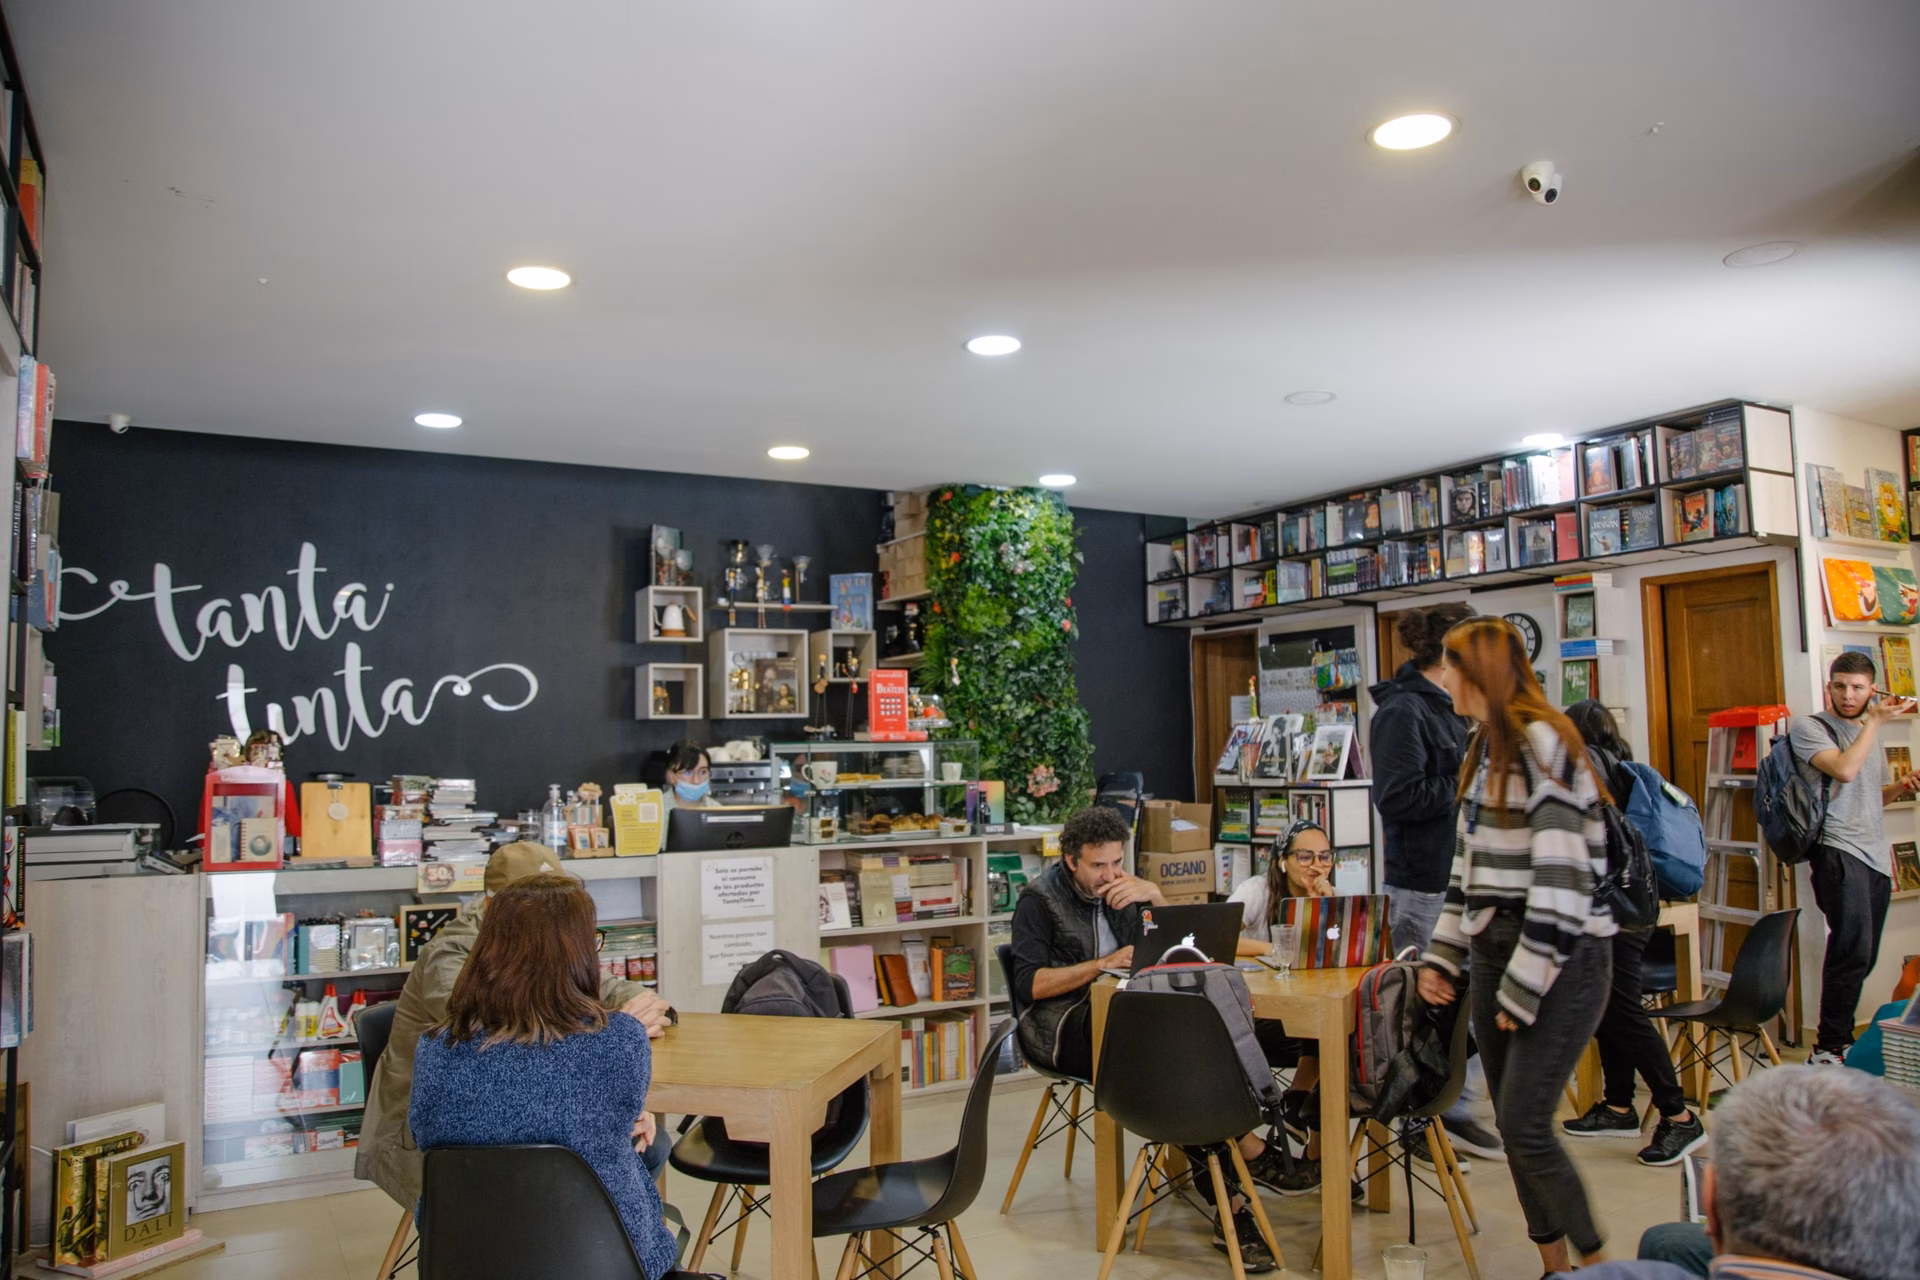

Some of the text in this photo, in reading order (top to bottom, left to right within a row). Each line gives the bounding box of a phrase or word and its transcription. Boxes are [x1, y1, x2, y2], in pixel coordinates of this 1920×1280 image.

[110, 541, 396, 662] tanta
[215, 642, 538, 752] tinta
[739, 866, 762, 874] permite
[1160, 860, 1206, 878] OCEANO
[734, 882, 764, 890] productos
